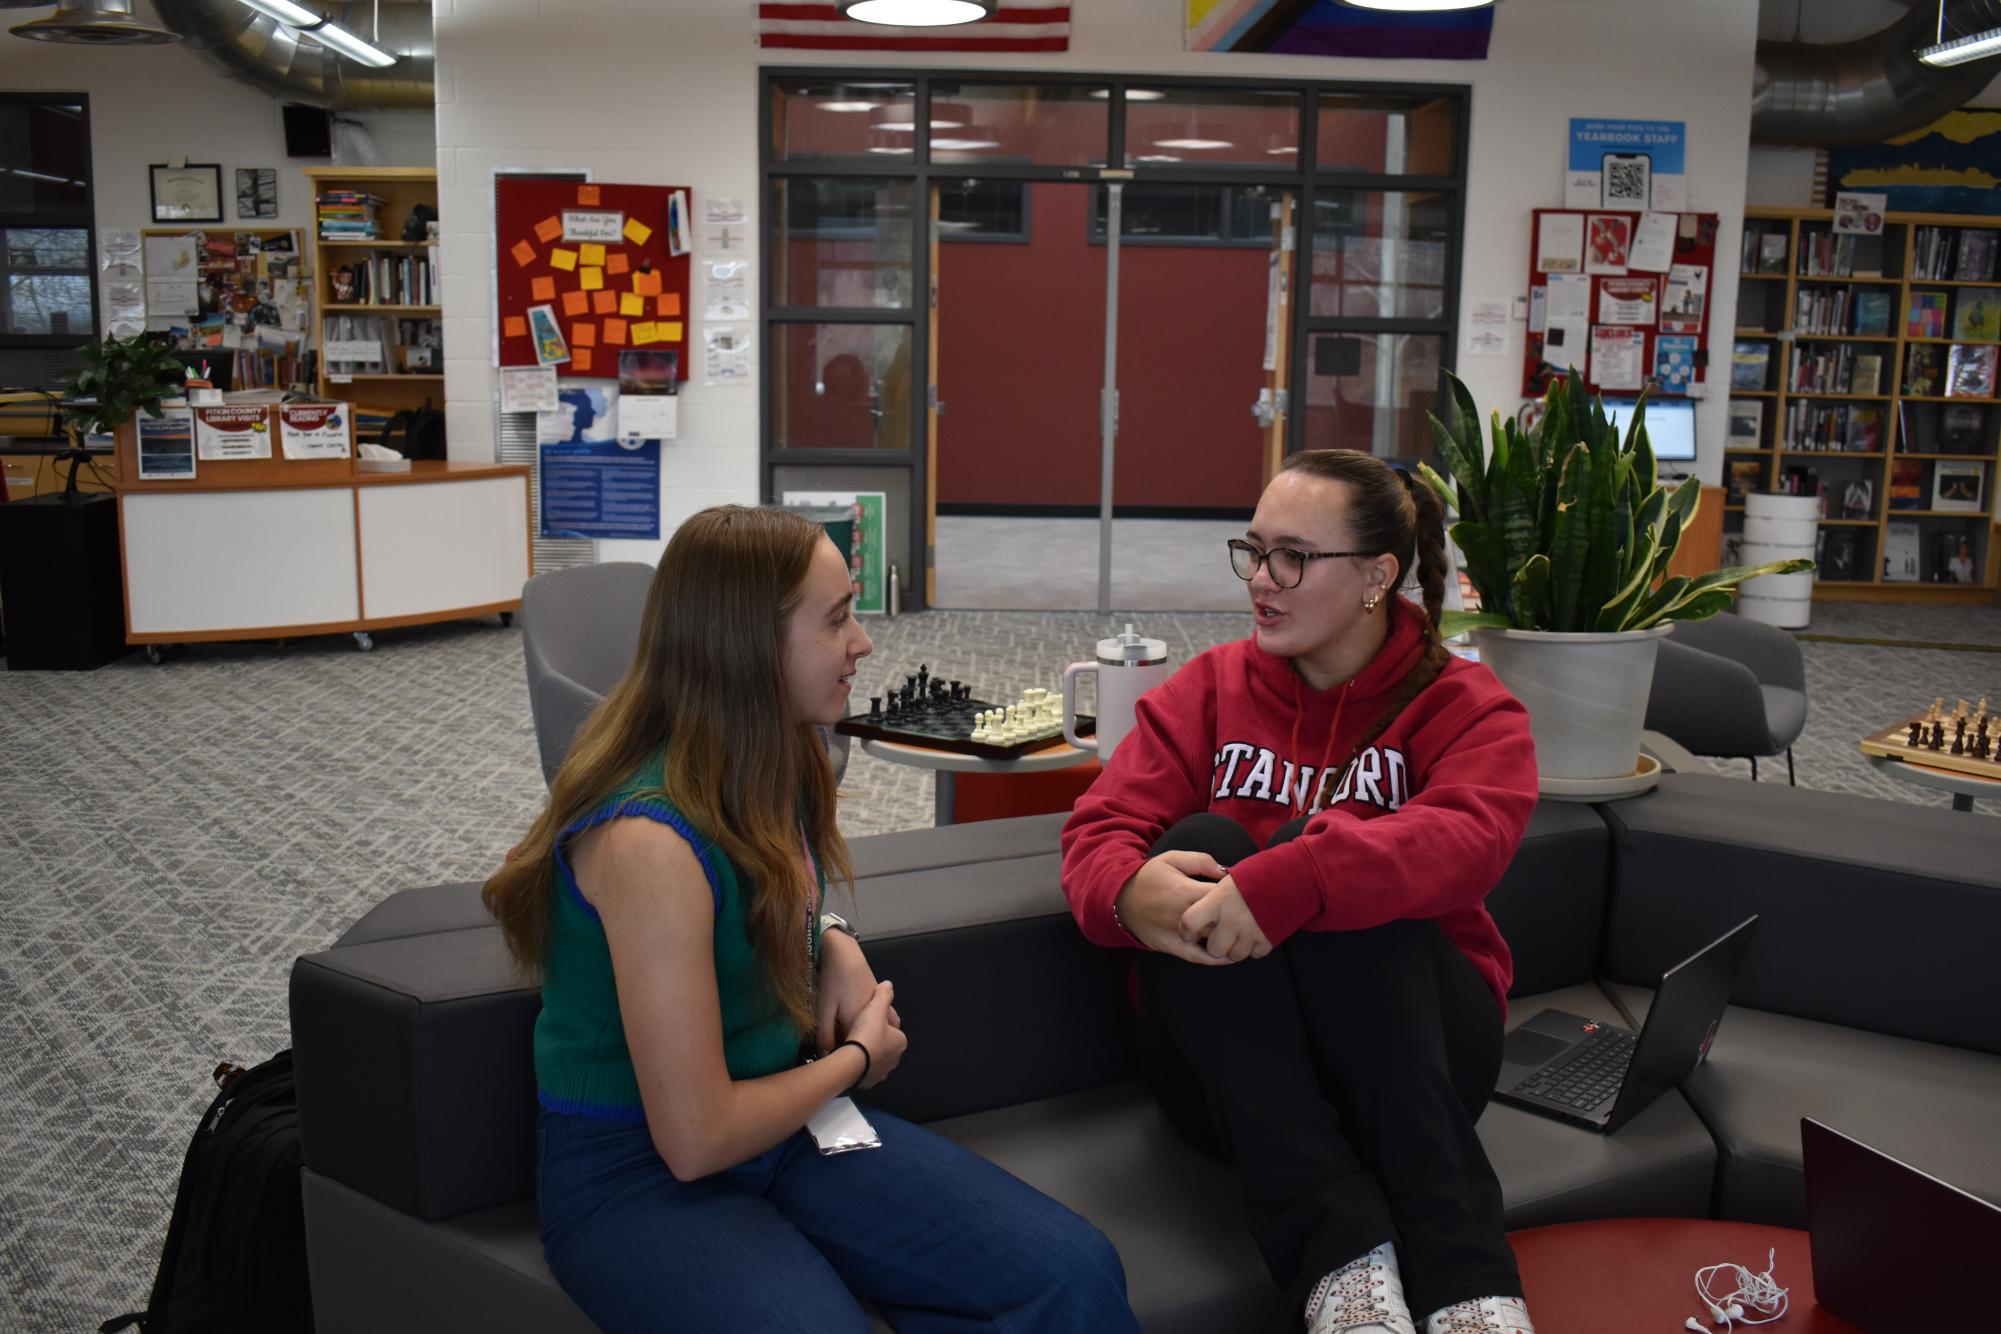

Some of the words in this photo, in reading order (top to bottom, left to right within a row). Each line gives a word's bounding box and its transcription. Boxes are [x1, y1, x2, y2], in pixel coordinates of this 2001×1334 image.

[1576, 132, 1641, 143] YEARBOOK
[1643, 133, 1679, 144] STAFF
[205, 408, 230, 416] PITKIN
[230, 407, 262, 415] COUNTY
[1211, 743, 1409, 816] TANFORD
